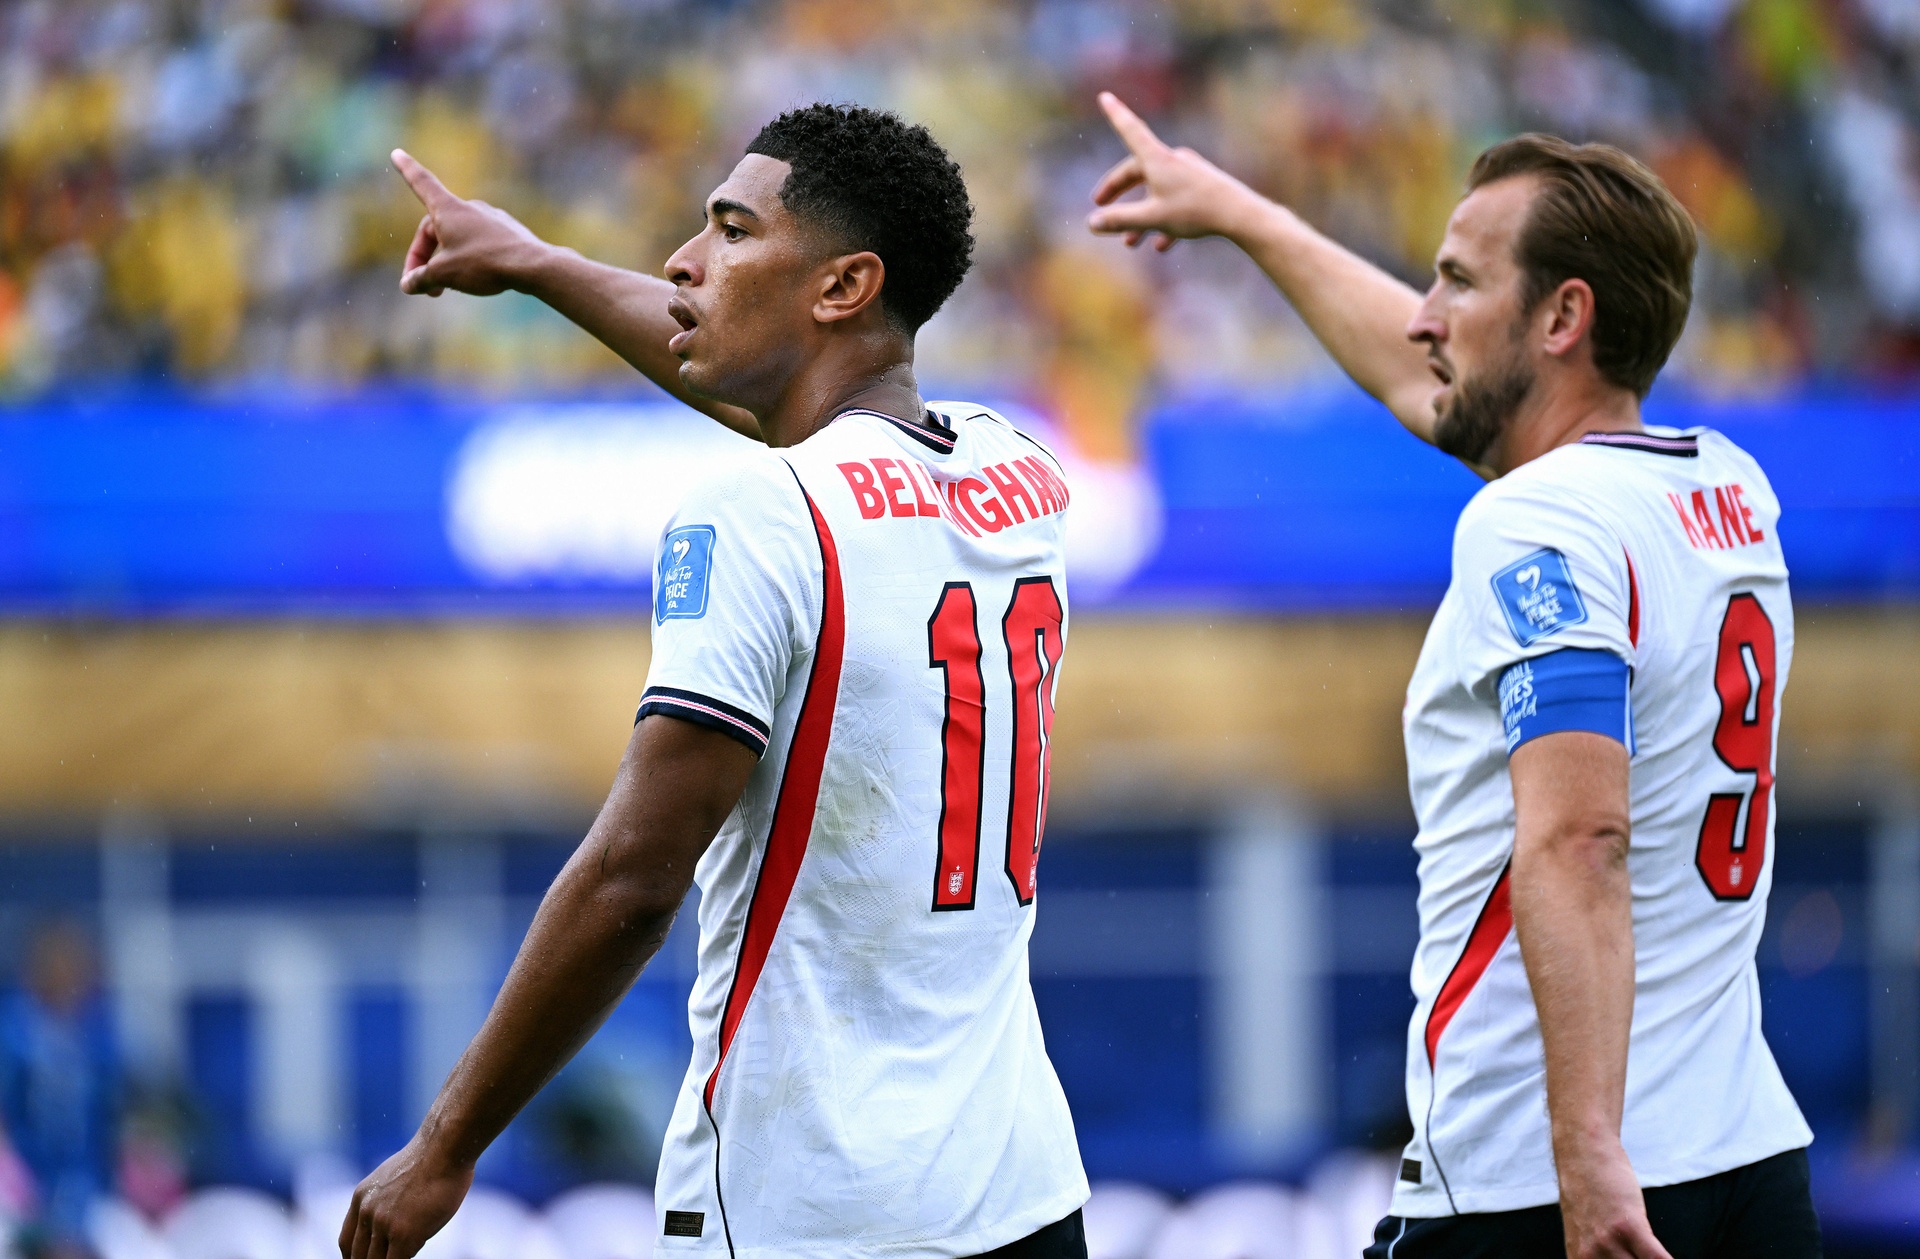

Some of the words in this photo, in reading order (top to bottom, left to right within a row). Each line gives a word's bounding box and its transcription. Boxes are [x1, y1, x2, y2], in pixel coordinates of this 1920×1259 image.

[836, 453, 1070, 538] BELNGHAM
[1667, 484, 1765, 550] KANE
[678, 565, 693, 582] For
[1525, 596, 1563, 627] PEACE
[927, 575, 1064, 912] 10
[1695, 592, 1776, 902] 9
